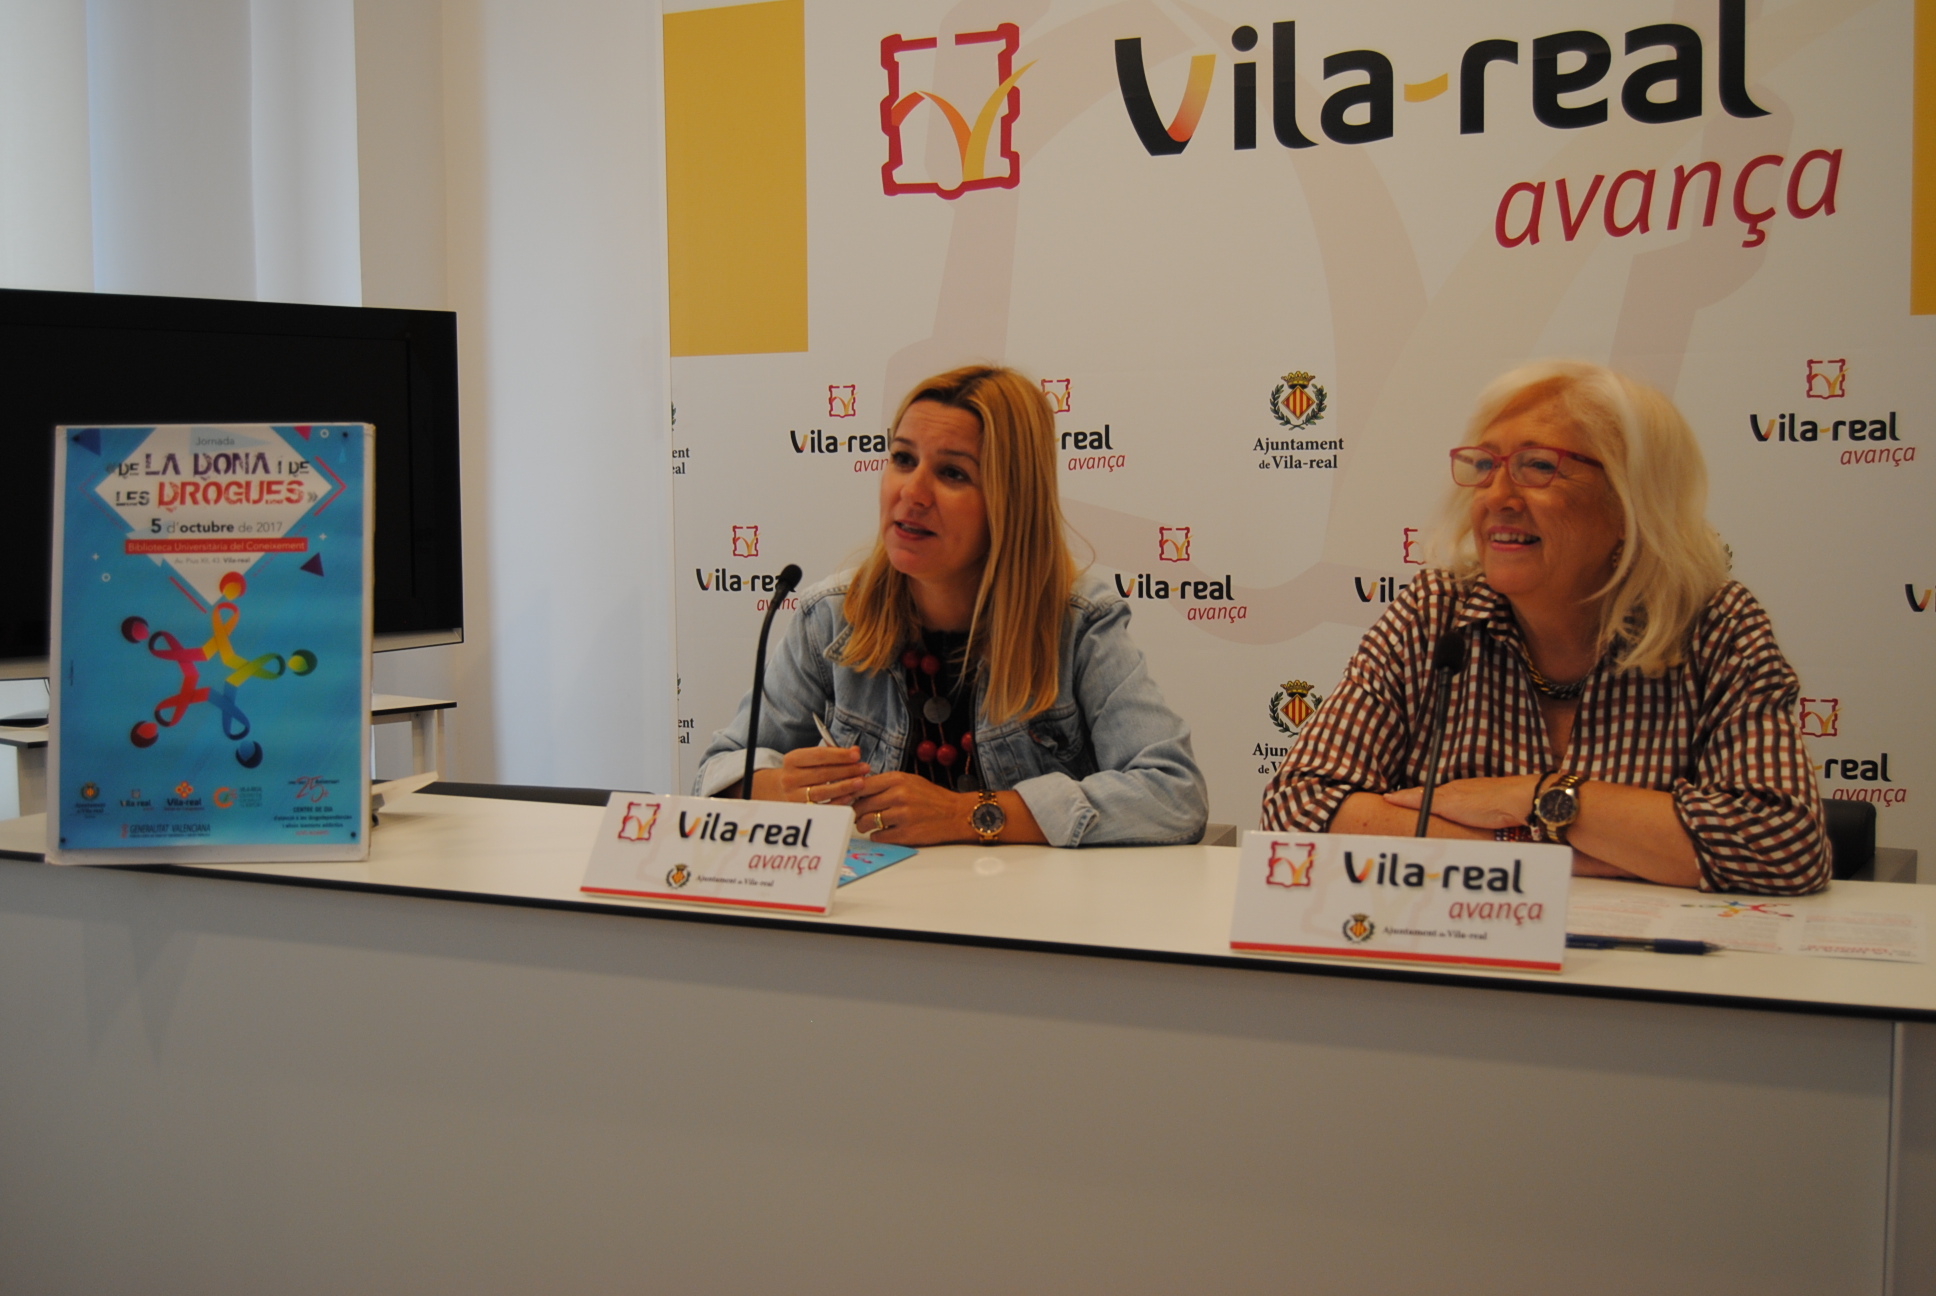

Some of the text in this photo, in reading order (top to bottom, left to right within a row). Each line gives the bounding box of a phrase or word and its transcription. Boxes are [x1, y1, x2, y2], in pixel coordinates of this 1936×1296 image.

[1115, 0, 1773, 157] Vila-real
[1494, 148, 1844, 249] avança
[1750, 411, 1901, 442] Vila-real
[195, 437, 235, 447] Jornada
[1253, 437, 1344, 455] Ajuntament
[145, 453, 181, 476] LA
[193, 452, 271, 480] DONA
[288, 460, 310, 477] DE
[1068, 454, 1126, 473] avança
[1258, 454, 1338, 469] de Vila-real
[1840, 446, 1916, 467] avança
[116, 490, 150, 507] LES
[151, 518, 162, 534] 5
[238, 522, 253, 533] de
[256, 522, 283, 533] 2017
[128, 542, 172, 552] Biblioteca
[231, 541, 243, 551] del
[245, 540, 306, 551] Coneixement
[1114, 573, 1235, 600] Vila-real
[1187, 605, 1247, 623] avança
[129, 824, 211, 834] GENERALITAT VALENCIANA
[679, 810, 813, 848] Vila-real
[748, 853, 821, 875] avança
[1344, 851, 1525, 894] Vila-real
[1448, 901, 1544, 926] avança
